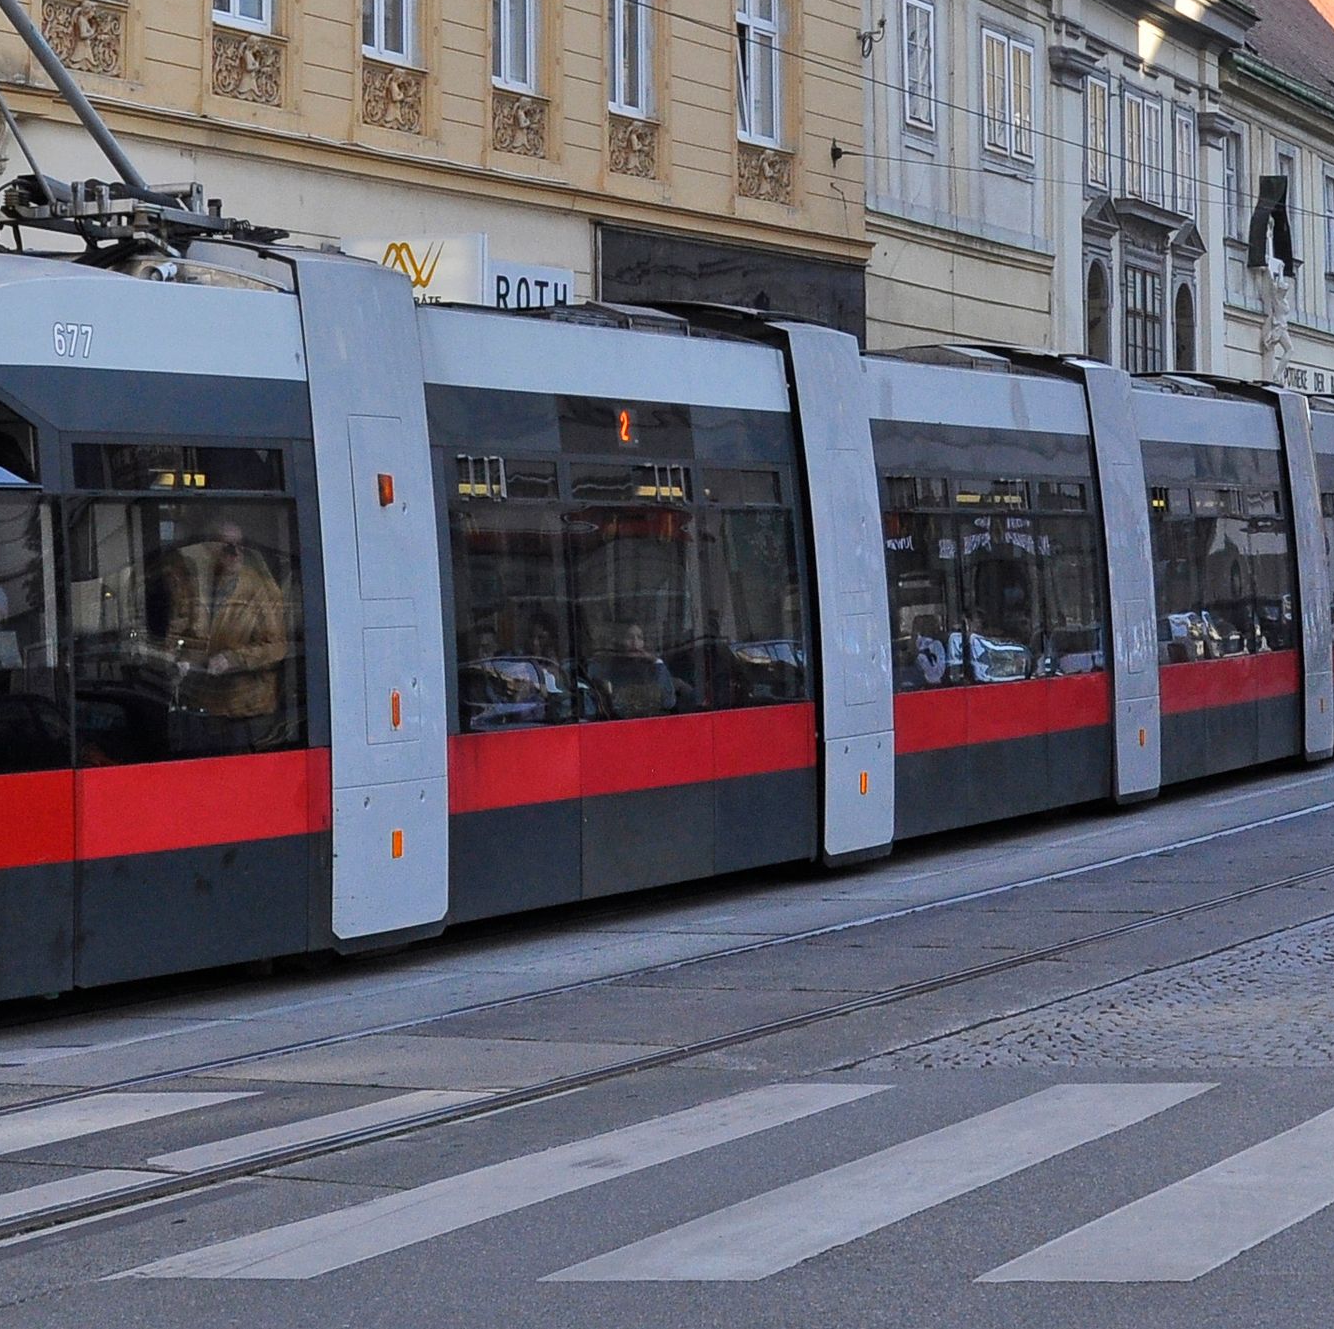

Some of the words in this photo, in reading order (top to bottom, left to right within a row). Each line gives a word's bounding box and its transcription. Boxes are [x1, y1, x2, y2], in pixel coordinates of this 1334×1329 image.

[414, 293, 442, 305] RÄTE
[496, 274, 567, 309] ROTH
[53, 321, 93, 359] 677
[1284, 367, 1307, 391] POTHEKE
[619, 410, 630, 441] 2
